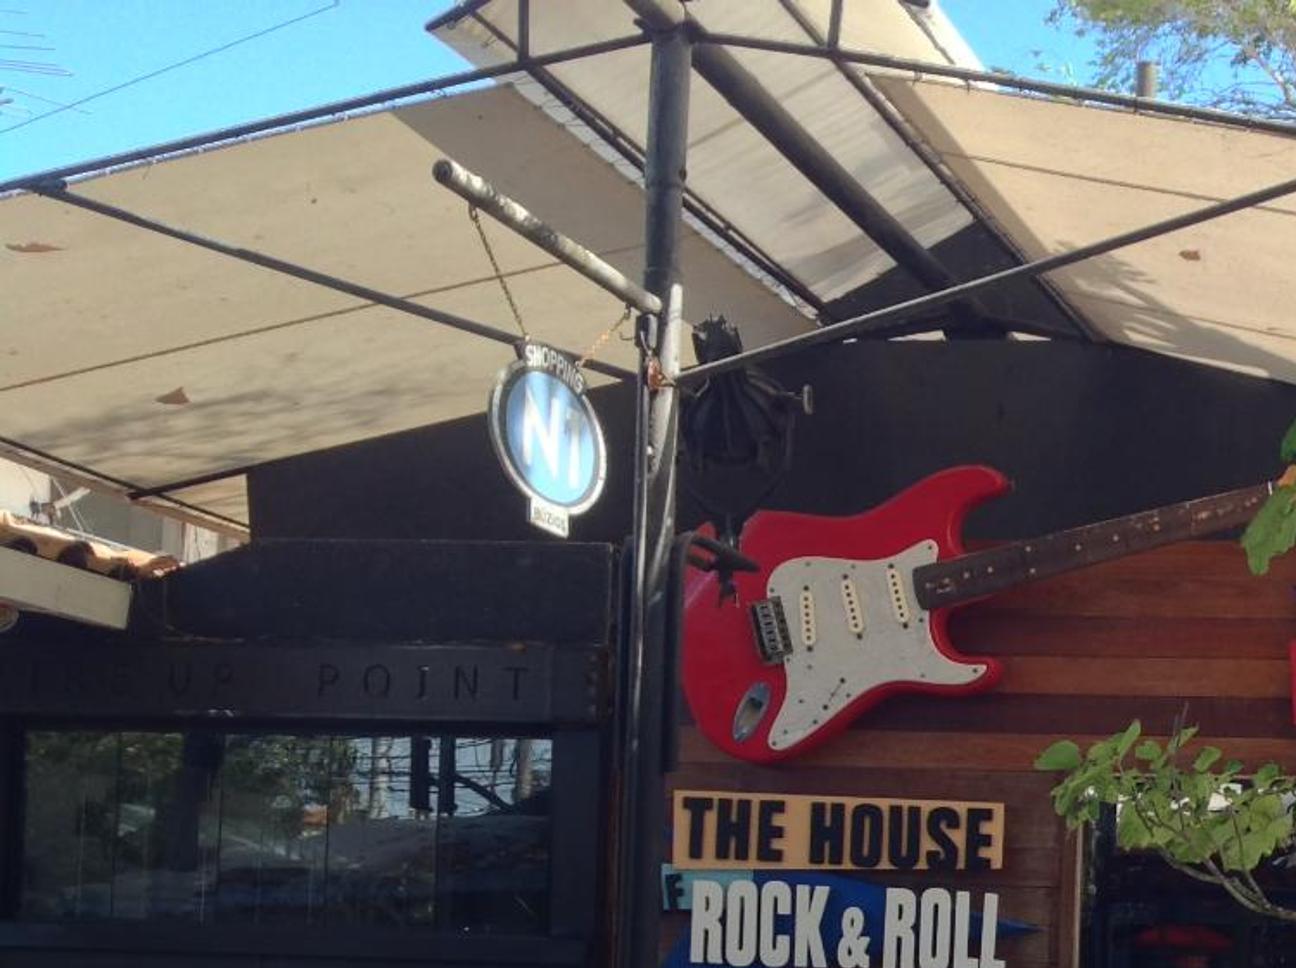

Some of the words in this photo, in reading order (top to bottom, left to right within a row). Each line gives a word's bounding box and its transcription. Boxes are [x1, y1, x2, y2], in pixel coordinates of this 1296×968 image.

[525, 344, 584, 394] SHOPPING
[317, 664, 530, 701] POINT
[682, 797, 786, 862] THE
[809, 802, 993, 870] HOUSE
[690, 880, 830, 968] ROCK
